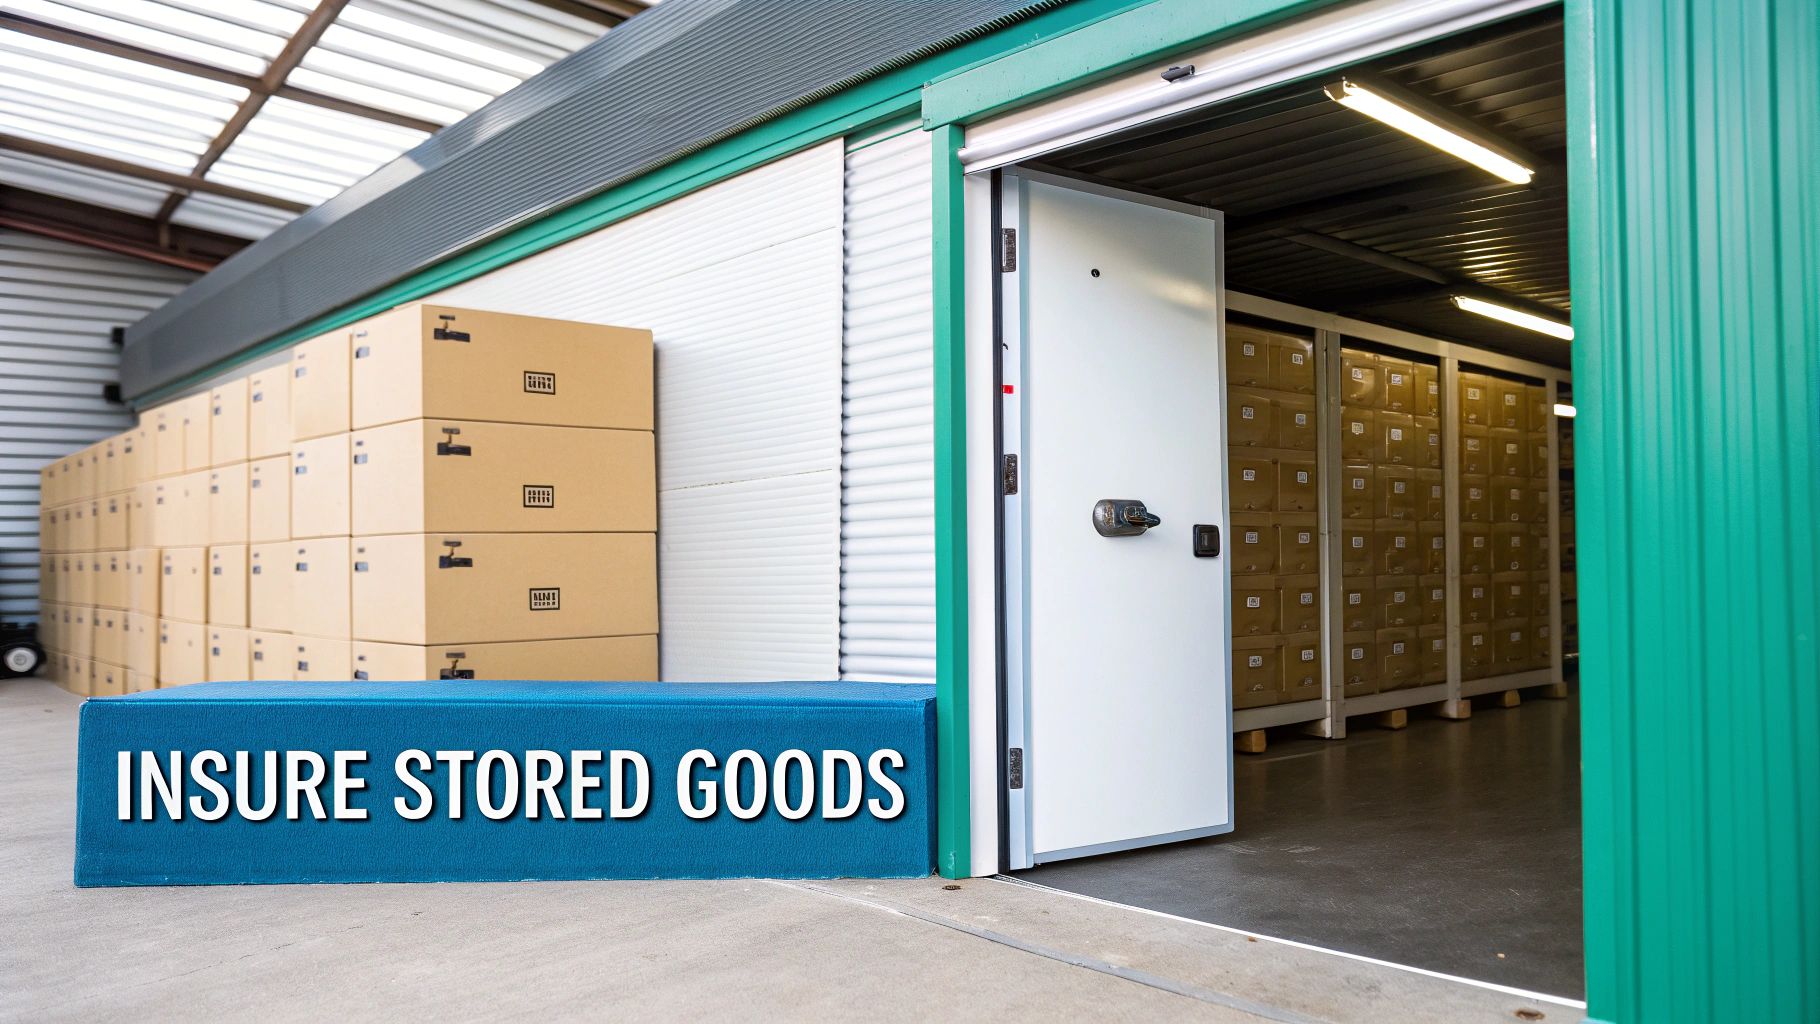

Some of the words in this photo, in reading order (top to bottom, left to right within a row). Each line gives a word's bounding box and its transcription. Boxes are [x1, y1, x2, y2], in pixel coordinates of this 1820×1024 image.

[117, 750, 367, 820] INSURE
[394, 749, 649, 820] STORED
[676, 748, 905, 820] GOODS
